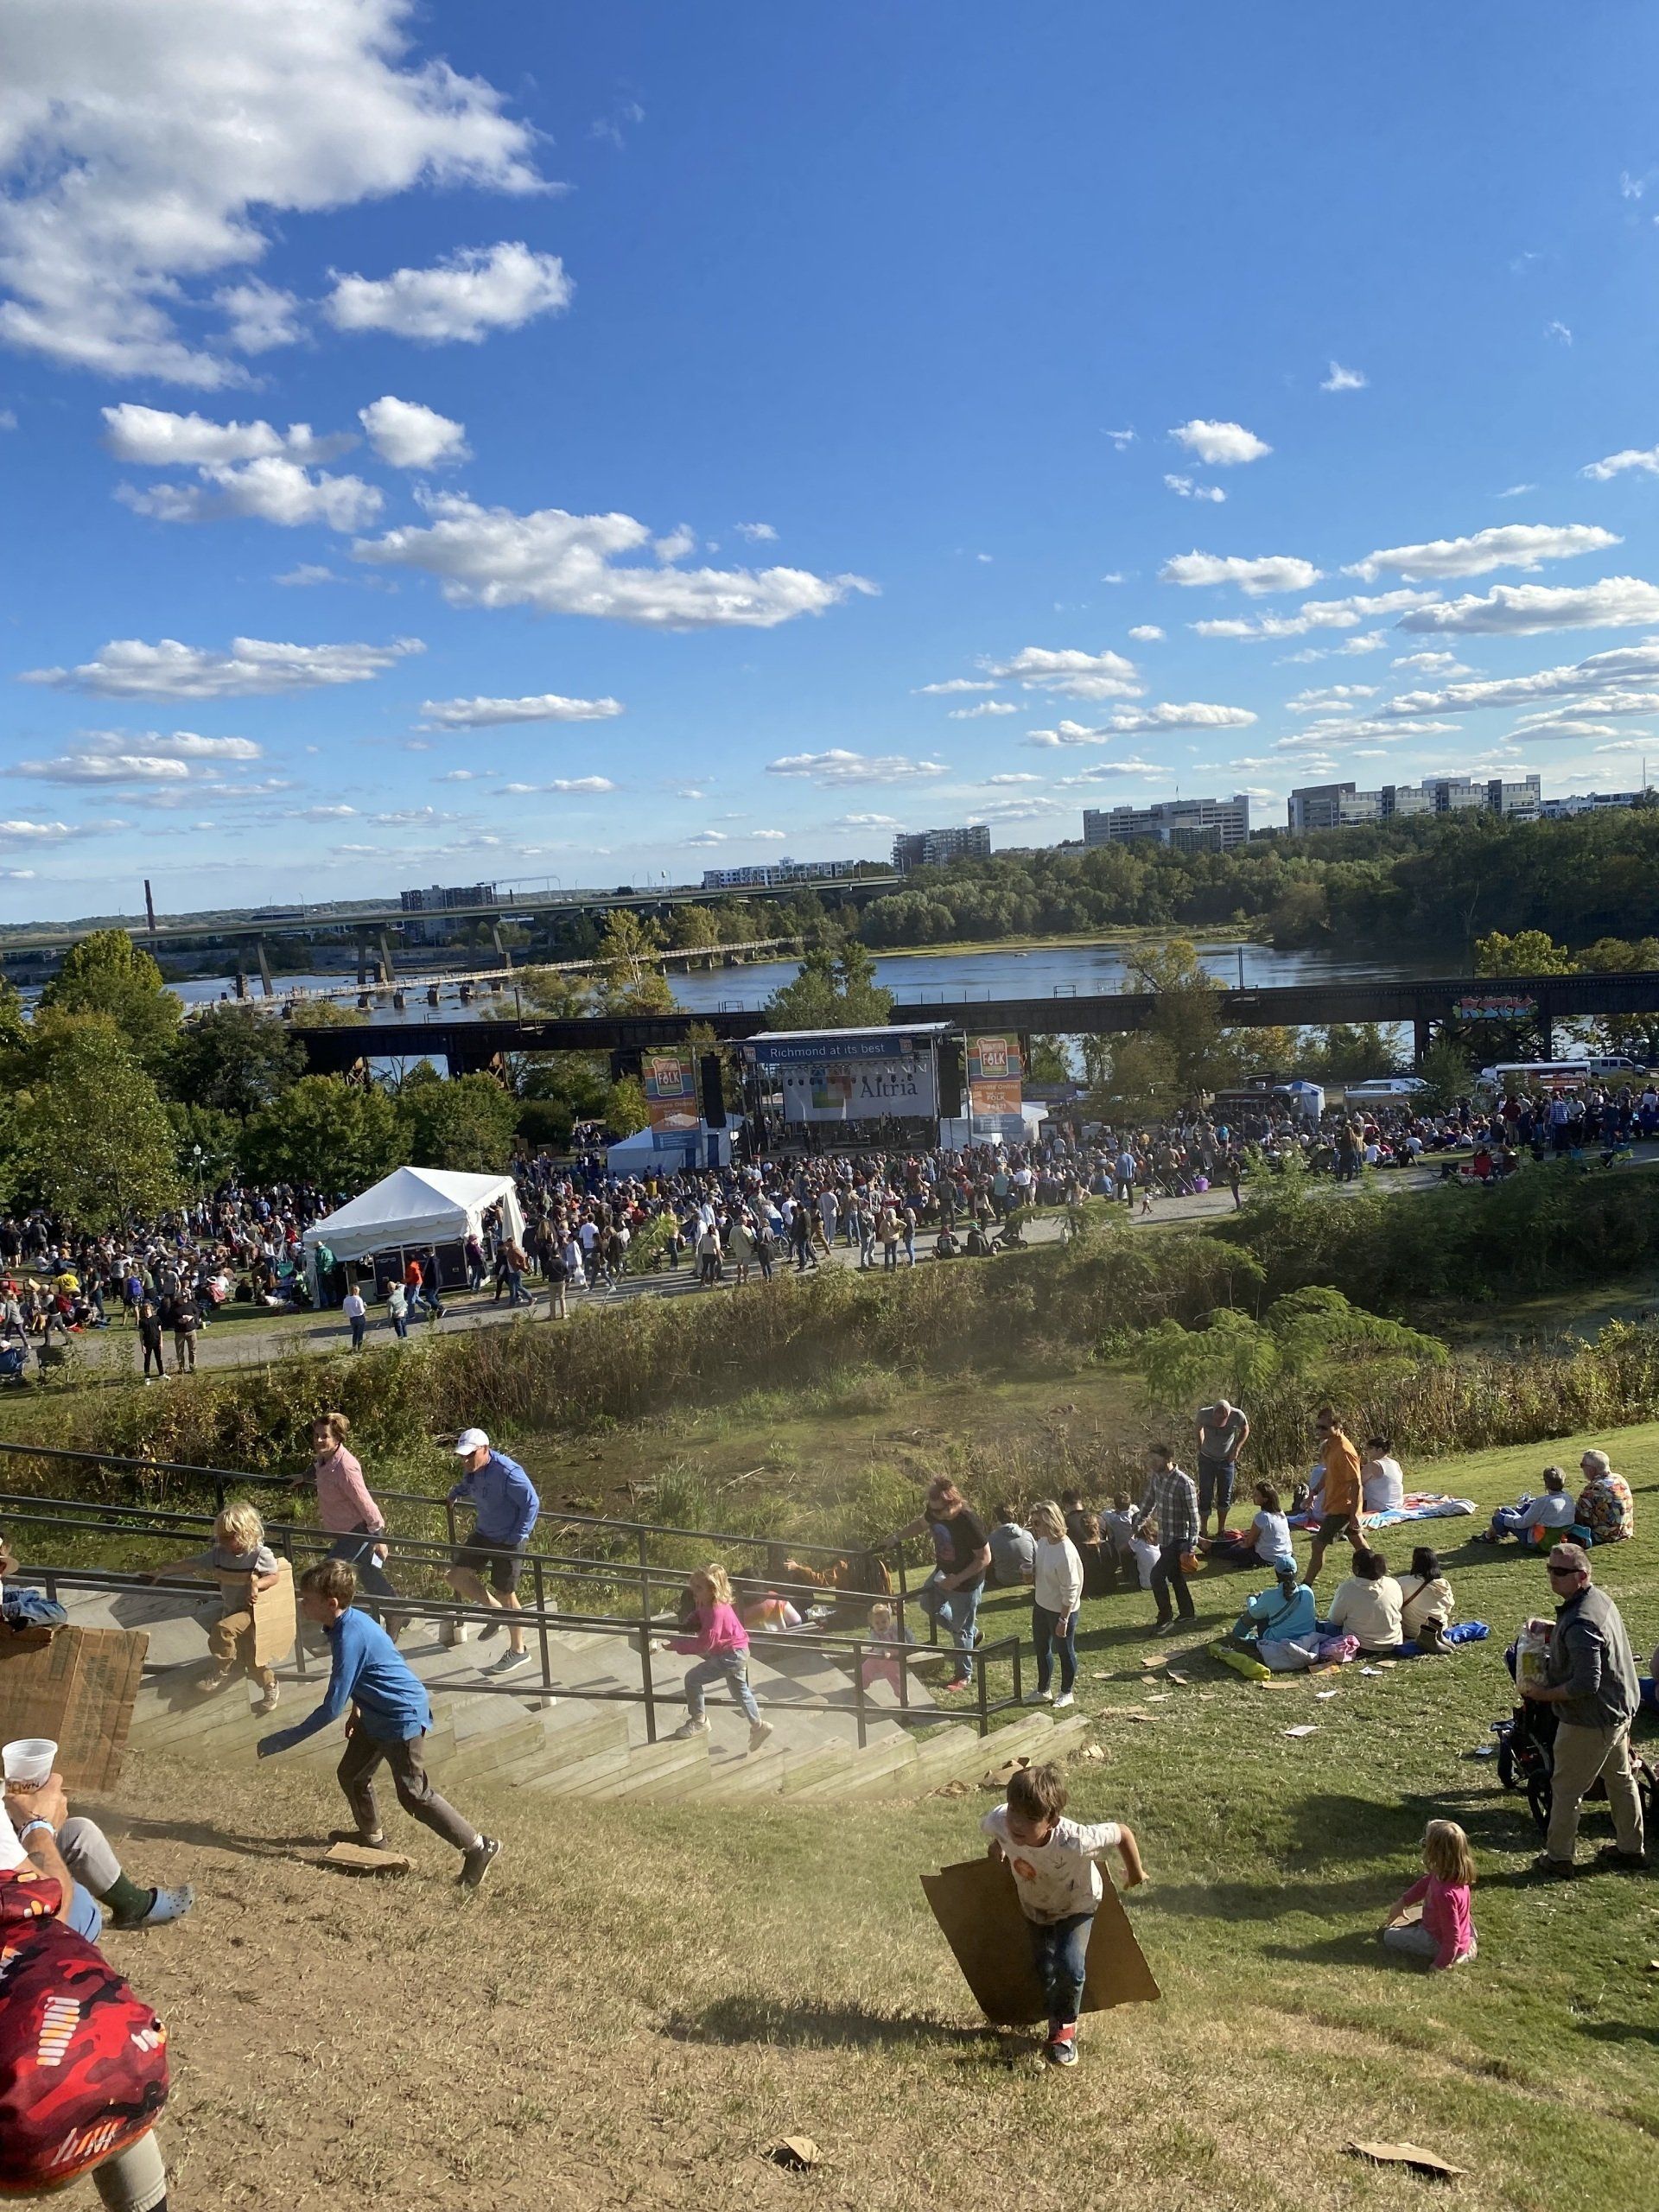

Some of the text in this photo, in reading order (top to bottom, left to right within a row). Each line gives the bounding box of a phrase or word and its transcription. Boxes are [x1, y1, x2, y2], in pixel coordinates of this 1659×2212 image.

[771, 1046, 826, 1058] Richmond
[844, 1045, 857, 1054] its
[861, 1043, 886, 1053] best
[982, 1052, 1006, 1065] FOLK
[658, 1071, 680, 1084] FOLK
[860, 1077, 918, 1098] Altria
